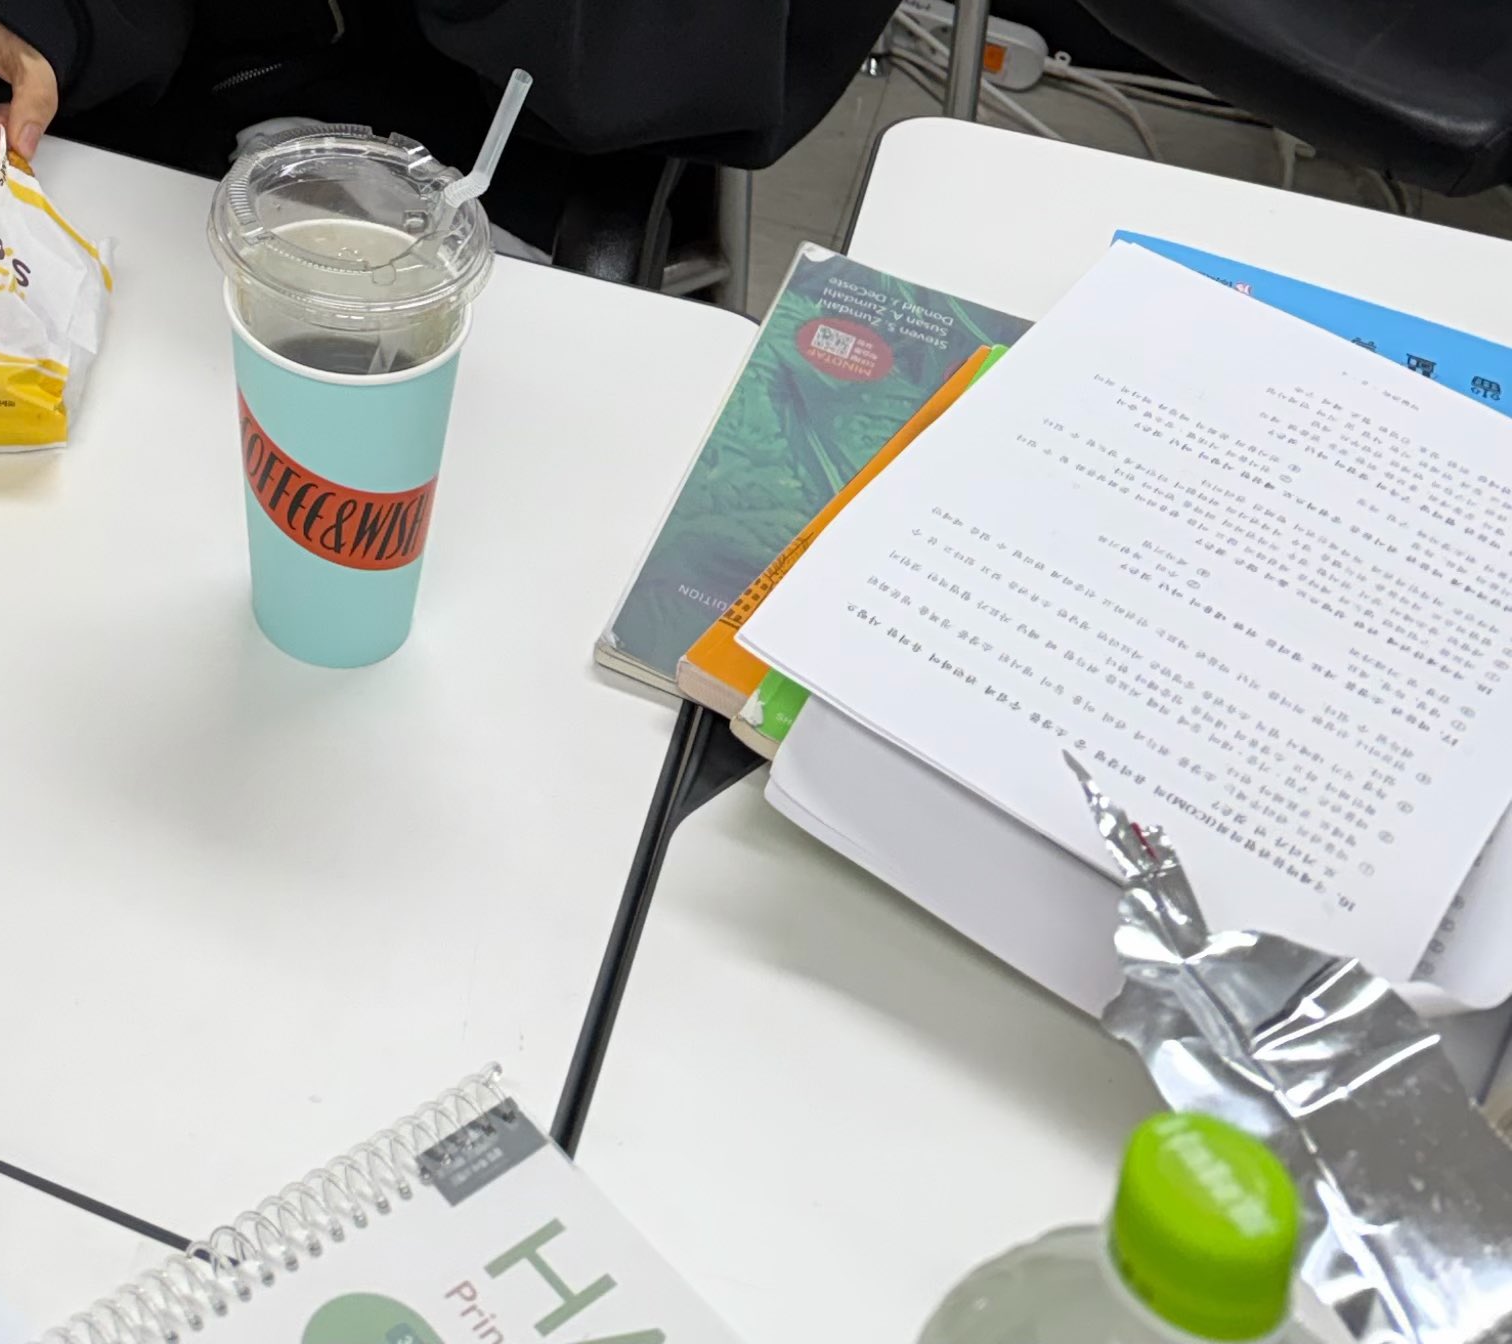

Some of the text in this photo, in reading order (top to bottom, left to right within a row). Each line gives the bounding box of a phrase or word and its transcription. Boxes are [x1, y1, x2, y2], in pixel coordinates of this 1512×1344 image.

[823, 287, 887, 315] Zumdahl
[828, 277, 888, 303] DeCoste
[818, 298, 882, 327] Zumdahl
[902, 302, 954, 327] Donald
[899, 326, 949, 350] Steven
[906, 316, 949, 338] Susan
[678, 584, 728, 612] DITION
[1439, 730, 1459, 747] 17.
[1336, 892, 1356, 912] 16.
